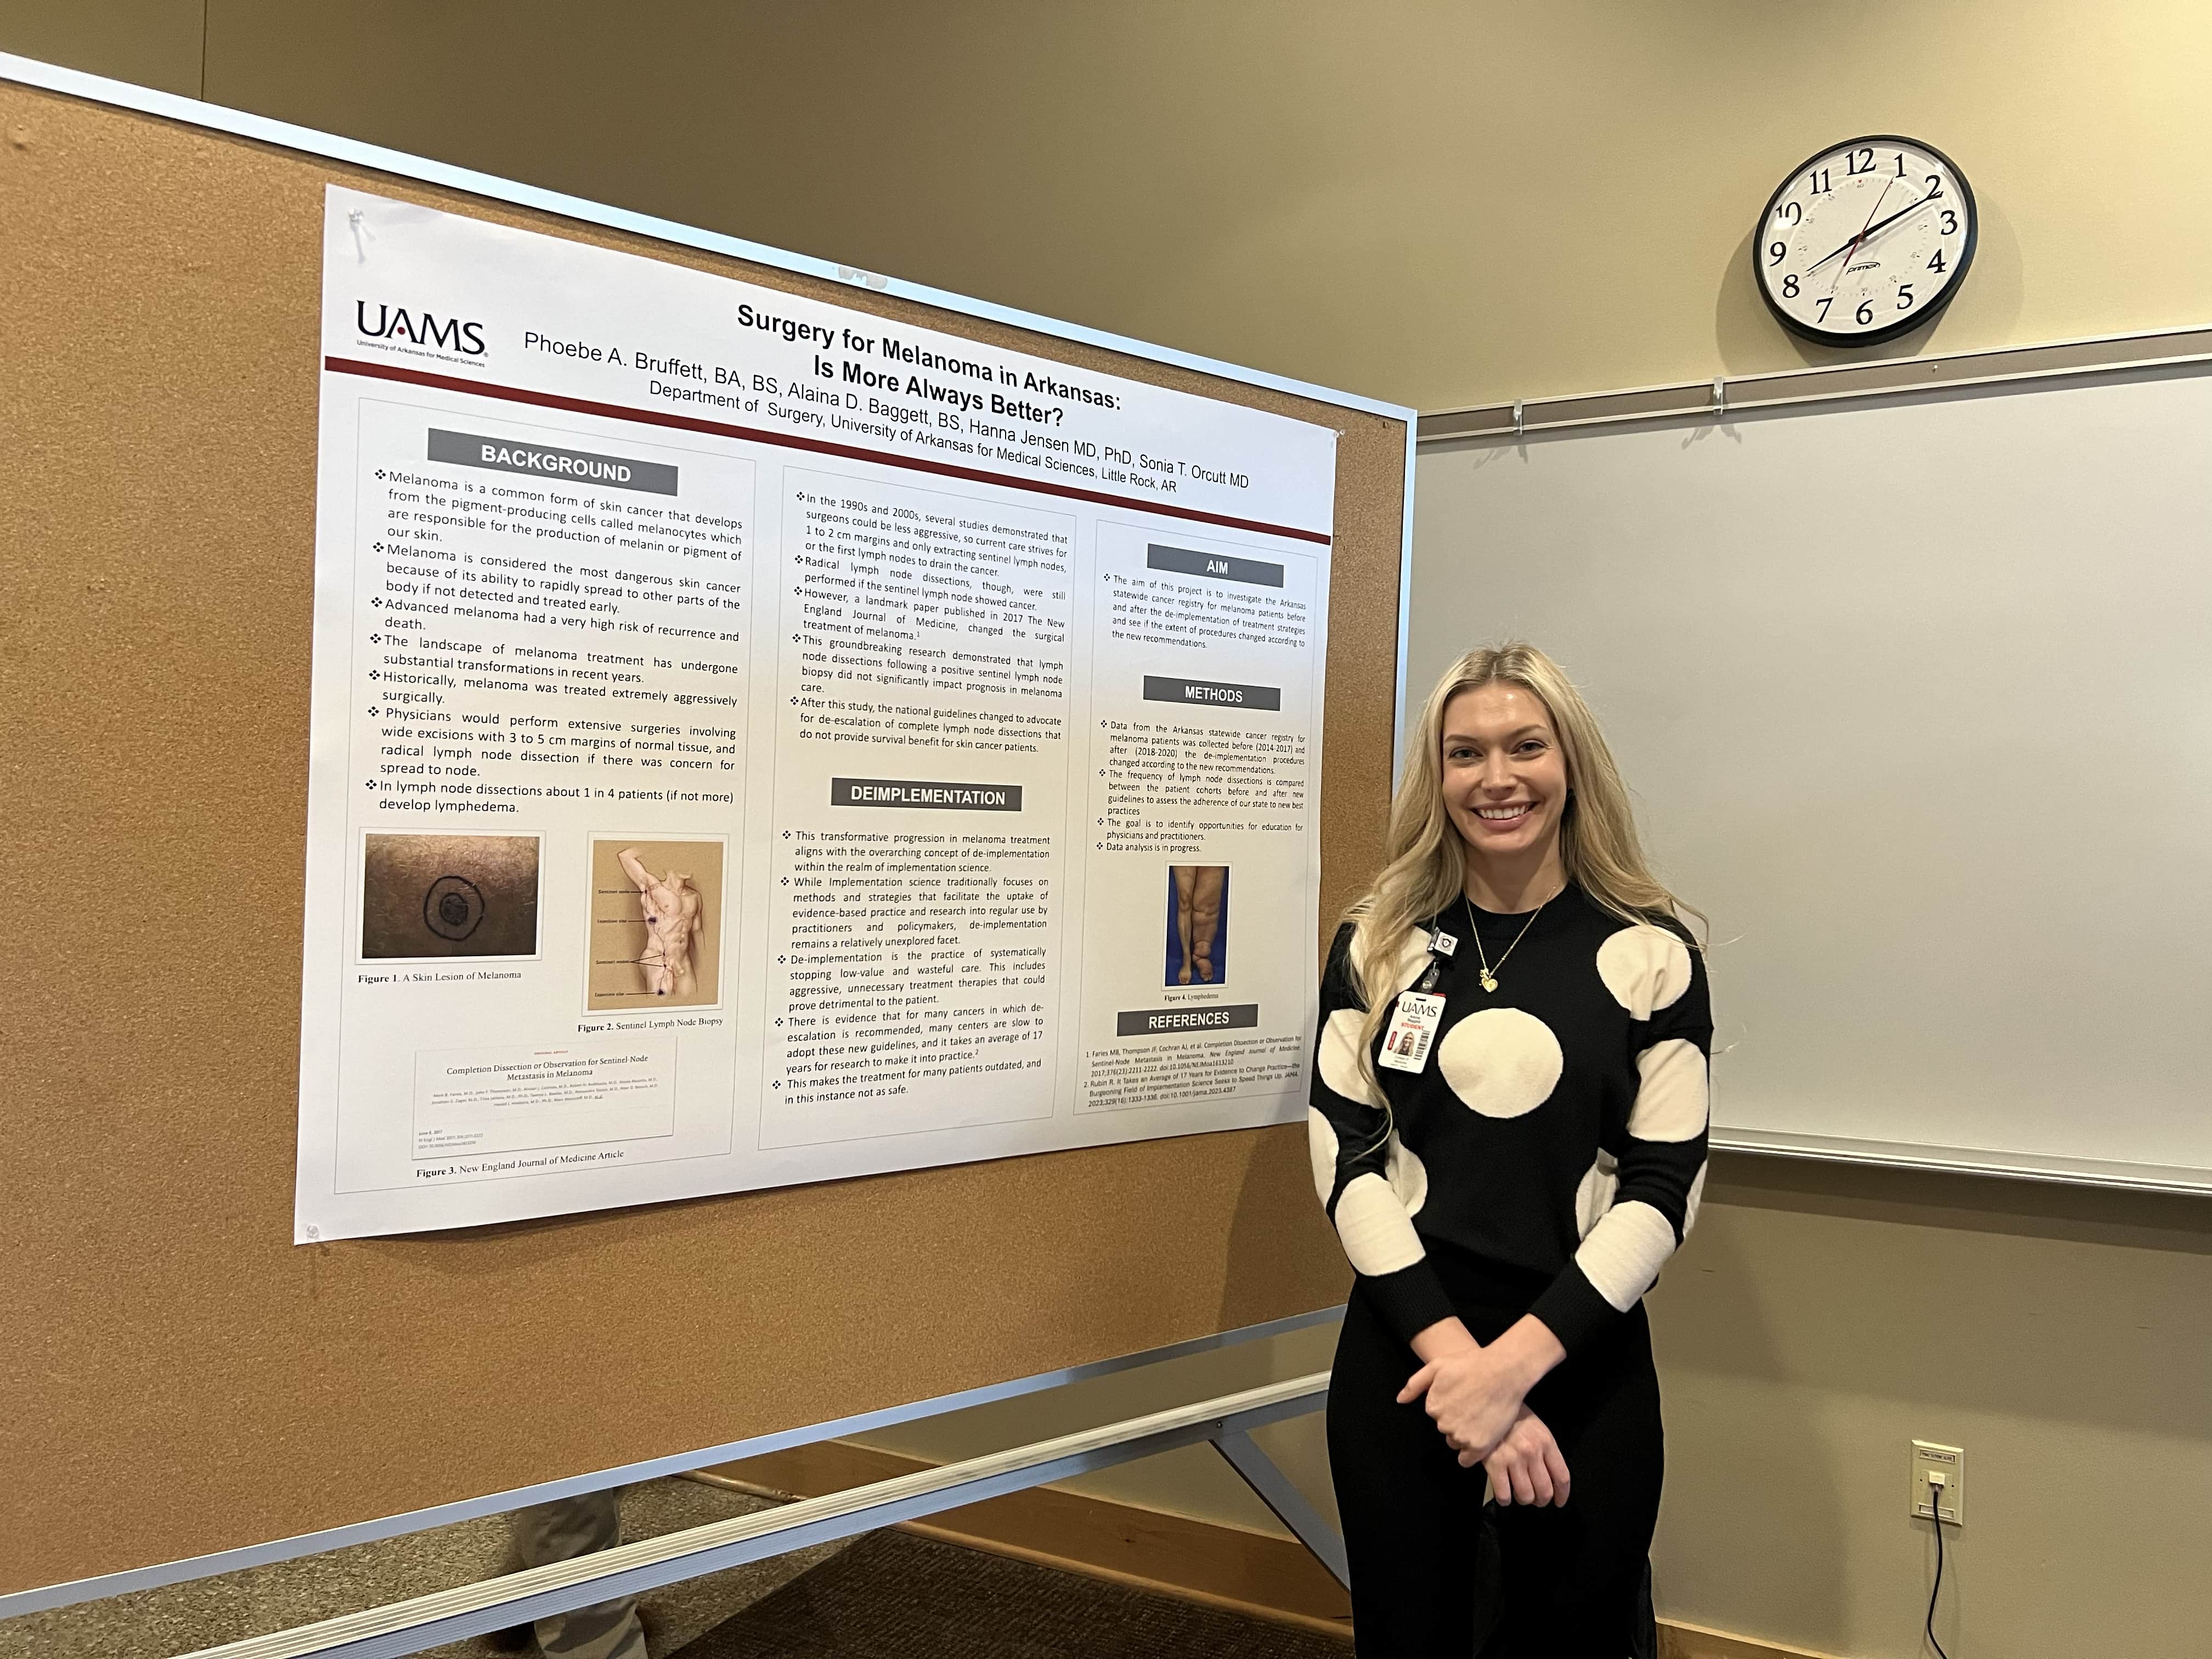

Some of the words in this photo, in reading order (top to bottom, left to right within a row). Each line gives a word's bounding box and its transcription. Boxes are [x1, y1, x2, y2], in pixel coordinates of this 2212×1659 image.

[1845, 148, 1876, 176] 12
[1894, 153, 1907, 178] 1
[1809, 168, 1832, 194] 11
[1925, 174, 1944, 200] 2
[1775, 202, 1802, 226] 10
[1940, 210, 1957, 235] 3
[1769, 241, 1787, 267] 9
[1926, 249, 1946, 273] 4
[1782, 274, 1800, 298] 8
[1897, 283, 1914, 309] 5
[1815, 297, 1834, 324] 7
[1856, 299, 1874, 325] 6
[357, 300, 486, 356] UAMS
[357, 339, 388, 351] University
[397, 346, 425, 357] Arkansas
[436, 353, 459, 363] Medical
[460, 358, 485, 368] Sciences
[737, 304, 834, 349] Surgery
[842, 328, 875, 354] for
[882, 337, 992, 381] Melanoma
[999, 365, 1017, 387] in
[1023, 371, 1120, 410] Arkansas:
[814, 354, 833, 378] Is
[843, 360, 899, 392] More
[905, 375, 983, 411] Always
[991, 393, 1063, 426] Better?
[524, 331, 602, 361] Phoebe
[607, 347, 627, 366] A.
[635, 351, 706, 383] Bruffett,
[715, 366, 744, 391] BA,
[753, 374, 782, 398] BS,
[787, 382, 839, 407] Alaina
[845, 393, 862, 411] D.
[869, 397, 932, 427] Baggett,
[938, 411, 963, 433] BS,
[969, 418, 1015, 442] Hanna
[1020, 429, 1069, 453] Jensen
[1074, 439, 1099, 461] MD,
[1104, 446, 1135, 468] PhD,
[1139, 454, 1173, 473] Sonia
[1177, 461, 1187, 476] T.
[1191, 465, 1226, 484] Orcutt
[1229, 472, 1249, 488] MD
[650, 380, 740, 409] Department
[744, 399, 759, 413] of
[768, 402, 825, 427] Surgery,
[831, 413, 896, 441] University
[900, 428, 913, 442] of
[915, 431, 973, 453] Arkansas
[977, 442, 993, 456] for
[997, 446, 1041, 466] Medical
[1045, 456, 1097, 479] Sciences,
[1102, 467, 1126, 483] Little
[1130, 472, 1158, 490] Rock,
[1161, 479, 1176, 493] AR
[481, 444, 631, 482] BACKGROUND
[389, 471, 458, 490] Melanoma
[464, 483, 473, 492] is
[479, 485, 486, 494] a
[492, 487, 544, 501] common
[550, 492, 577, 506] form
[583, 498, 595, 509] of
[600, 500, 622, 512] skin
[627, 506, 663, 518] cancer
[668, 510, 690, 522] that
[695, 514, 742, 530] develops
[806, 493, 815, 504] In
[820, 495, 836, 506] the
[840, 499, 868, 512] 1990s
[871, 505, 888, 515] and
[892, 507, 921, 522] 2000s,
[925, 515, 955, 526] several
[958, 520, 988, 531] studies
[992, 523, 1048, 541] demonstrated
[1051, 533, 1068, 544] that
[1206, 559, 1228, 574] AIM
[1111, 629, 1124, 639] the
[1126, 633, 1142, 641] new
[382, 690, 445, 706] surgically.
[1185, 685, 1243, 702] METHODS
[1109, 744, 1127, 754] after
[1135, 746, 1177, 759] (2018-2020)
[1184, 749, 1197, 758] the
[1204, 751, 1266, 763] de-implementation
[1273, 756, 1305, 765] procedures
[379, 798, 430, 812] develop
[435, 799, 518, 813] lymphedema.
[851, 786, 1005, 805] DEIMPLEMENTATION
[795, 830, 815, 840] This
[820, 831, 889, 842] transformative
[894, 835, 945, 844] progression
[949, 833, 957, 843] in
[962, 834, 1006, 843] melanoma
[1010, 836, 1050, 844] treatment
[1106, 842, 1123, 851] Data
[1125, 842, 1153, 853] analysis
[1154, 843, 1160, 851] is
[1161, 843, 1169, 851] in
[792, 923, 852, 935] practitioners
[866, 922, 883, 931] and
[897, 921, 956, 933] policymakers,
[969, 919, 1047, 930] de-implementation
[357, 974, 389, 985] Figure
[412, 973, 432, 981] Skin
[477, 971, 521, 979] Melanoma
[1148, 1011, 1229, 1029] REFERENCES
[1402, 1002, 1438, 1017] UAMS
[578, 1024, 605, 1033] Figure
[616, 1020, 646, 1030] Sentinel
[648, 1019, 674, 1029] Lymph
[676, 1018, 696, 1026] Node
[698, 1017, 723, 1026] Biopsy
[446, 1066, 492, 1075] Completion
[493, 1064, 532, 1072] Dissection
[543, 1059, 586, 1069] Observation
[416, 1169, 446, 1178] Figure
[448, 1166, 456, 1175] 3.
[459, 1165, 479, 1173] New
[481, 1160, 515, 1172] England
[517, 1157, 546, 1167] Journal
[549, 1156, 559, 1164] of
[560, 1154, 596, 1163] Medicine
[597, 1150, 624, 1160] Article
